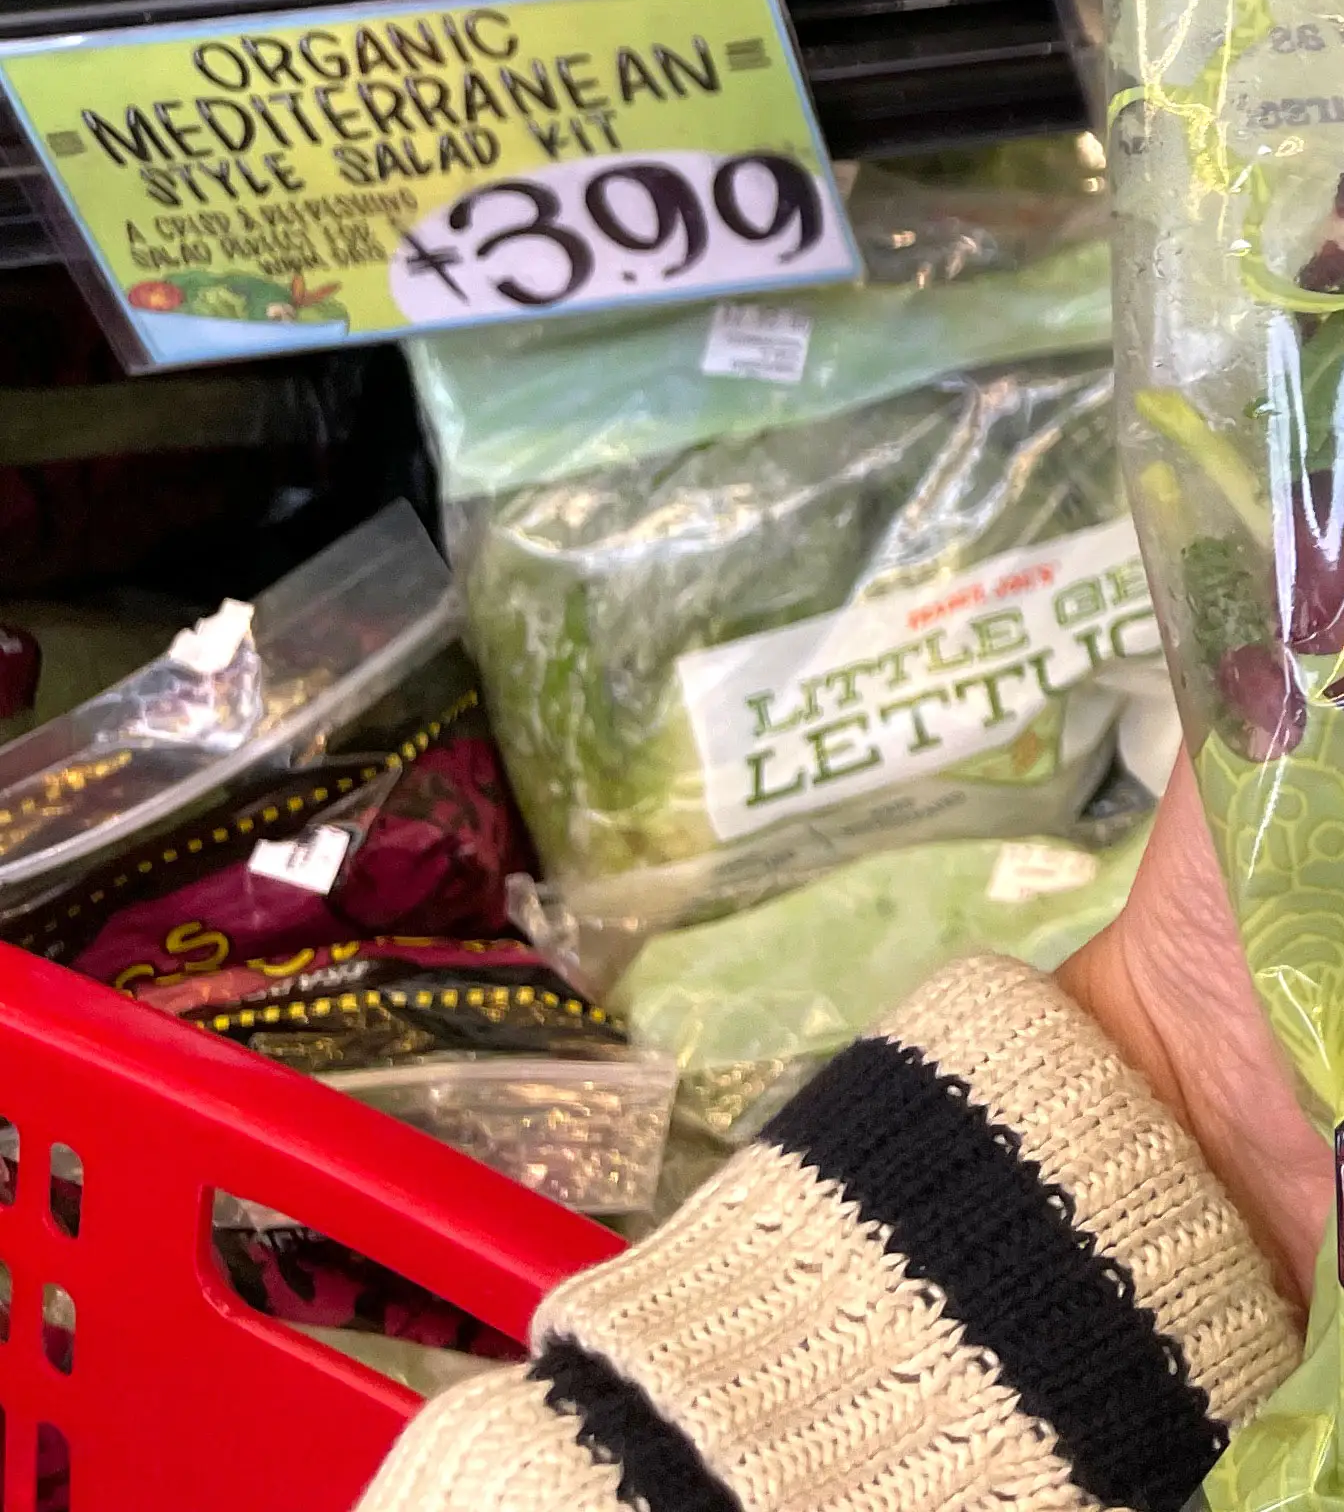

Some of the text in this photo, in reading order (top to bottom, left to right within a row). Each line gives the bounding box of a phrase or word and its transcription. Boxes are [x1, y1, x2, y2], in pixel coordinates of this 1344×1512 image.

[81, 36, 725, 169] MEDITERRANEAN
[193, 9, 520, 91] ORGANIC
[140, 109, 624, 207] STYLE SALAD KIT
[744, 602, 1031, 738] LITTLE
